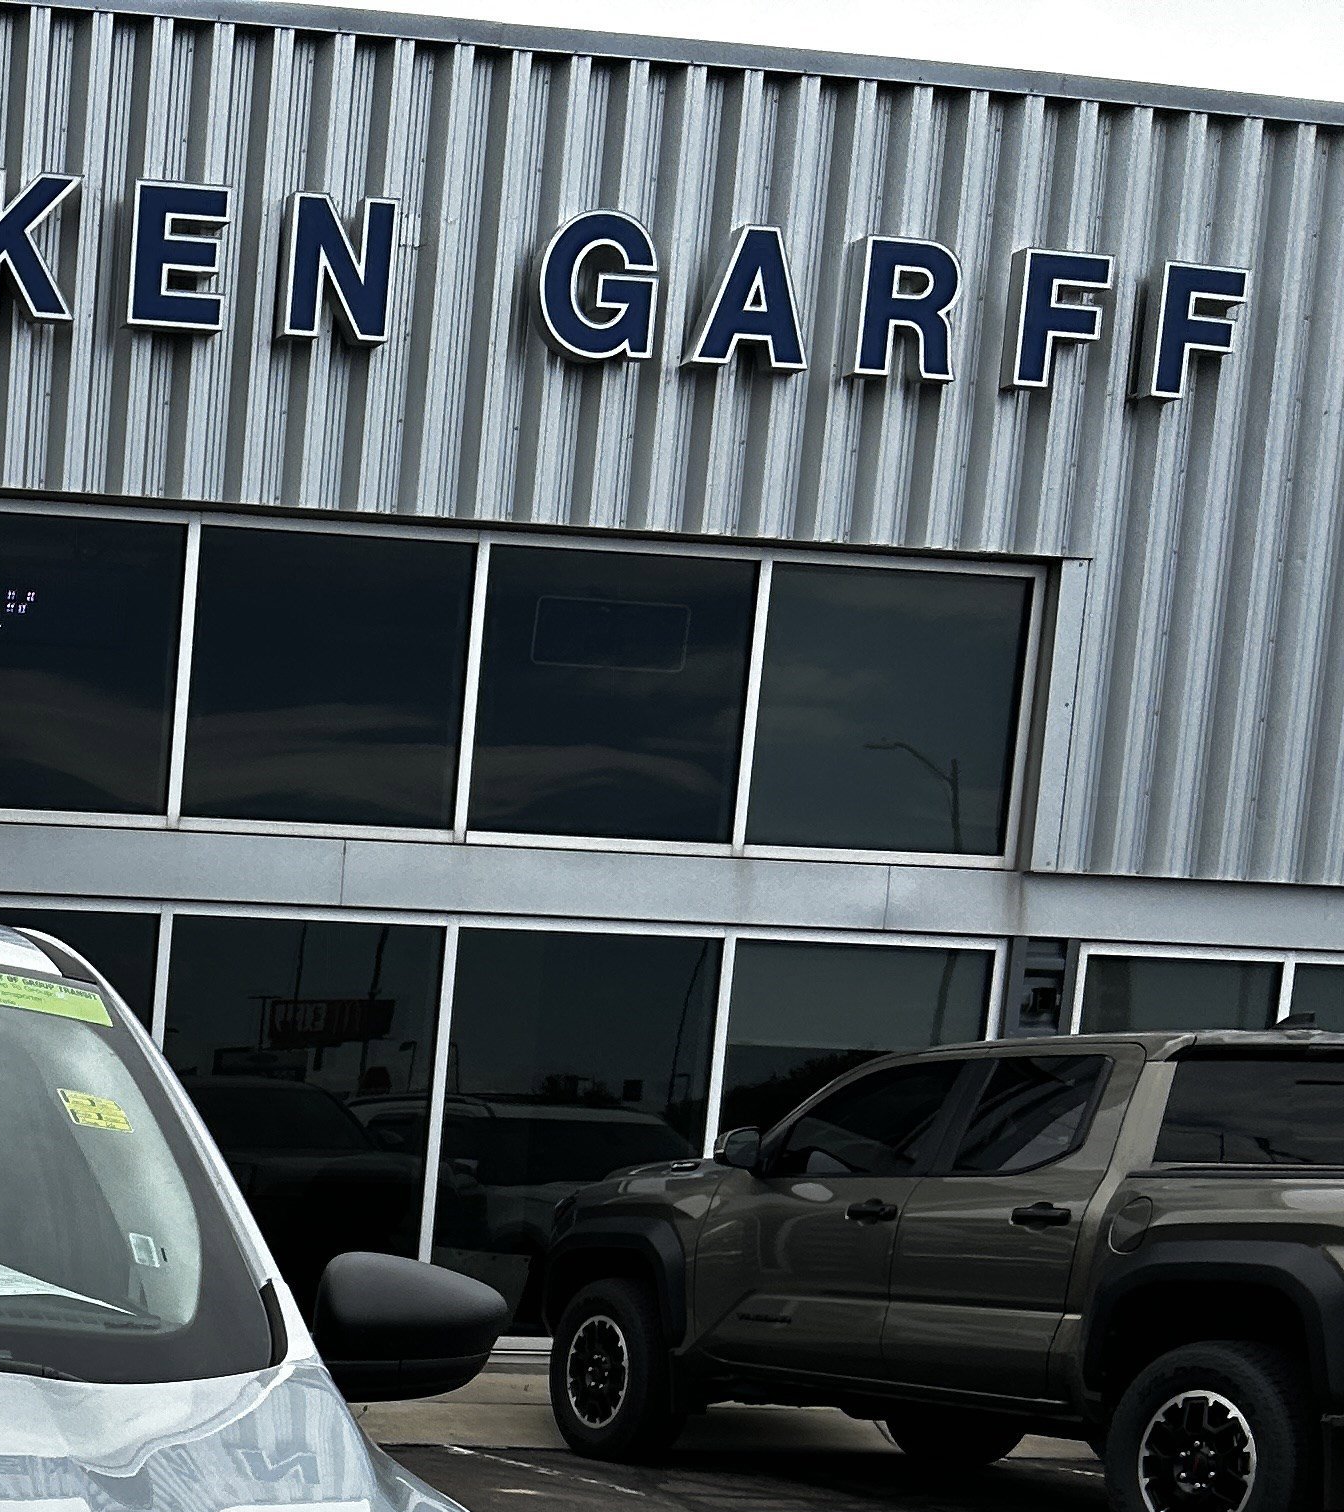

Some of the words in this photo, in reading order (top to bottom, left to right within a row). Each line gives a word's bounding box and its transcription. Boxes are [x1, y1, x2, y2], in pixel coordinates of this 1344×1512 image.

[536, 206, 1253, 401] GARFF
[8, 975, 19, 984] OF
[23, 978, 55, 991] GROUP
[58, 985, 98, 1001] TRANSIT
